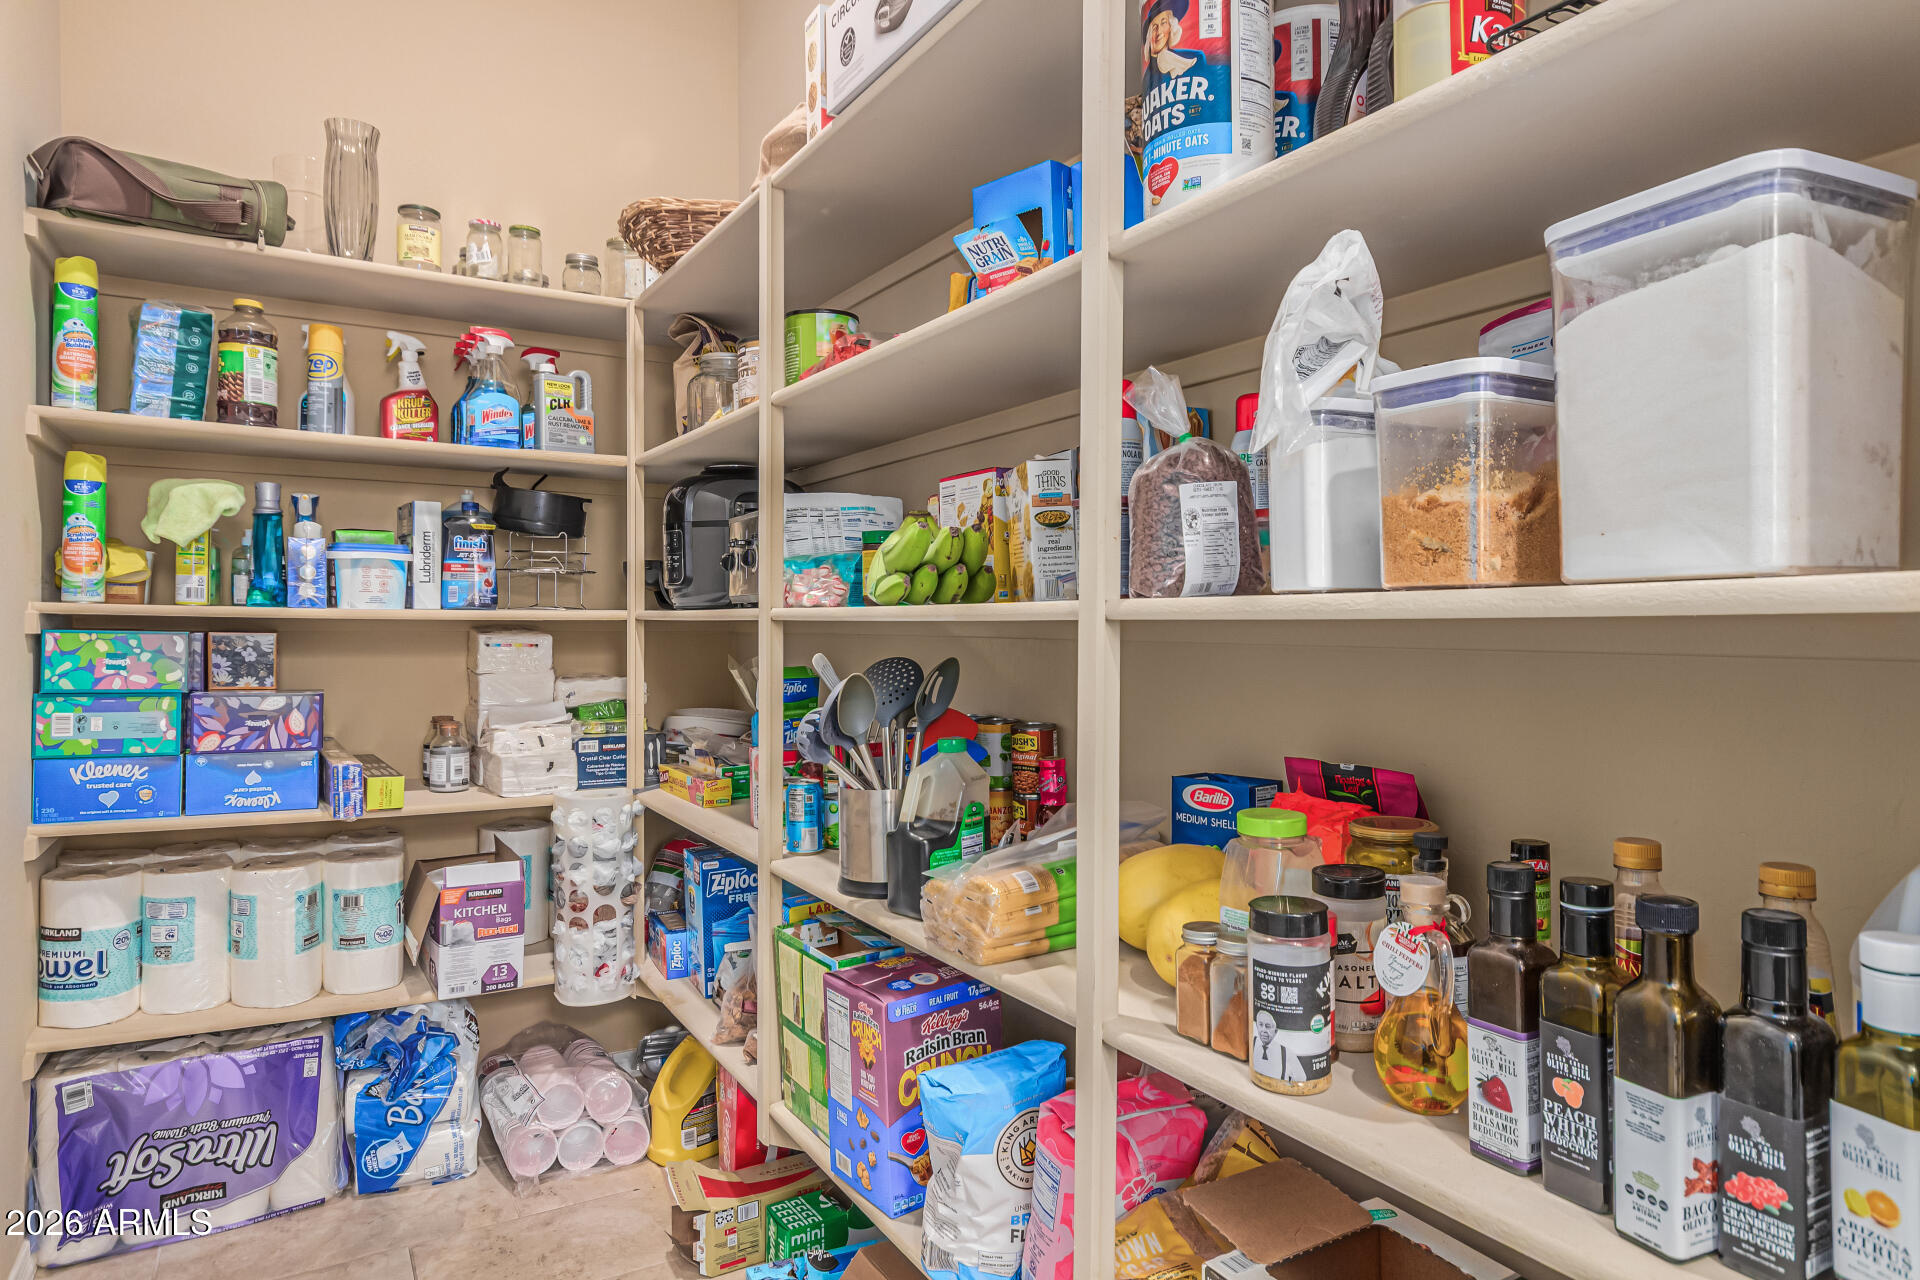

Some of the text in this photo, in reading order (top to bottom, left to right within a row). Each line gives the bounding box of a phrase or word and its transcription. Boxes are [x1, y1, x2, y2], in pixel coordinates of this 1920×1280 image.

[1142, 103, 1186, 142] OATS
[1185, 134, 1209, 148] OATS
[966, 236, 1007, 260] NUTRI
[976, 244, 1014, 268] GRAIN
[393, 408, 431, 419] KUTTER
[397, 398, 422, 408] KRUD
[549, 398, 570, 410] CLR
[482, 408, 514, 424] Windex
[1035, 474, 1066, 488] THINS
[454, 536, 486, 549] finish
[419, 531, 431, 584] Lubriderm
[69, 760, 150, 785] Kleenex
[224, 790, 282, 809] Kleenex
[1194, 790, 1230, 806] Barilla
[1176, 812, 1208, 826] MEDIUM
[468, 888, 502, 898] KIRKLAND
[711, 871, 758, 896] Ziploc
[454, 904, 506, 918] KITCHEN
[496, 915, 512, 924] Bags
[671, 940, 684, 970] Ziploc
[492, 964, 508, 976] 13
[498, 982, 514, 990] BAGS
[968, 986, 979, 996] 17g
[928, 991, 958, 1006] REAL FRUIT
[921, 1008, 970, 1035] Kellogg's
[851, 1020, 882, 1052] CRUNCH
[904, 1029, 987, 1069] Raisin Bran
[1472, 1054, 1518, 1078] OLIVE MILL
[1546, 1058, 1590, 1080] OLIVE MILL
[152, 1110, 272, 1140] Premium Bath Tissue
[1472, 1102, 1518, 1126] STRAWBERRY
[1472, 1110, 1518, 1138] BALSAMIC
[1543, 1098, 1598, 1130] PEACH
[1543, 1110, 1598, 1142] WHITE
[1002, 1125, 1020, 1152] KING
[1473, 1121, 1518, 1148] REDUCTION
[1544, 1122, 1598, 1152] BALSAMIC
[1544, 1129, 1598, 1160] REDUCTION
[98, 1121, 280, 1196] UltraSoft
[366, 1154, 374, 1173] WIDE
[370, 1148, 380, 1174] SHEETS
[1728, 1140, 1786, 1172] OLIVE MILL
[1842, 1149, 1902, 1182] OLIVE MILL
[759, 1162, 804, 1176] CAFFEINE
[1004, 1164, 1030, 1184] BAKING
[162, 1188, 223, 1210] KIRKLAND
[791, 1224, 824, 1247] mini
[1682, 1215, 1709, 1232] OLIVE
[1722, 1206, 1795, 1244] CRANBERRY
[1722, 1222, 1795, 1262] REDUCTION
[1838, 1227, 1912, 1270] CITRUS
[1840, 1217, 1910, 1256] ARIZONA
